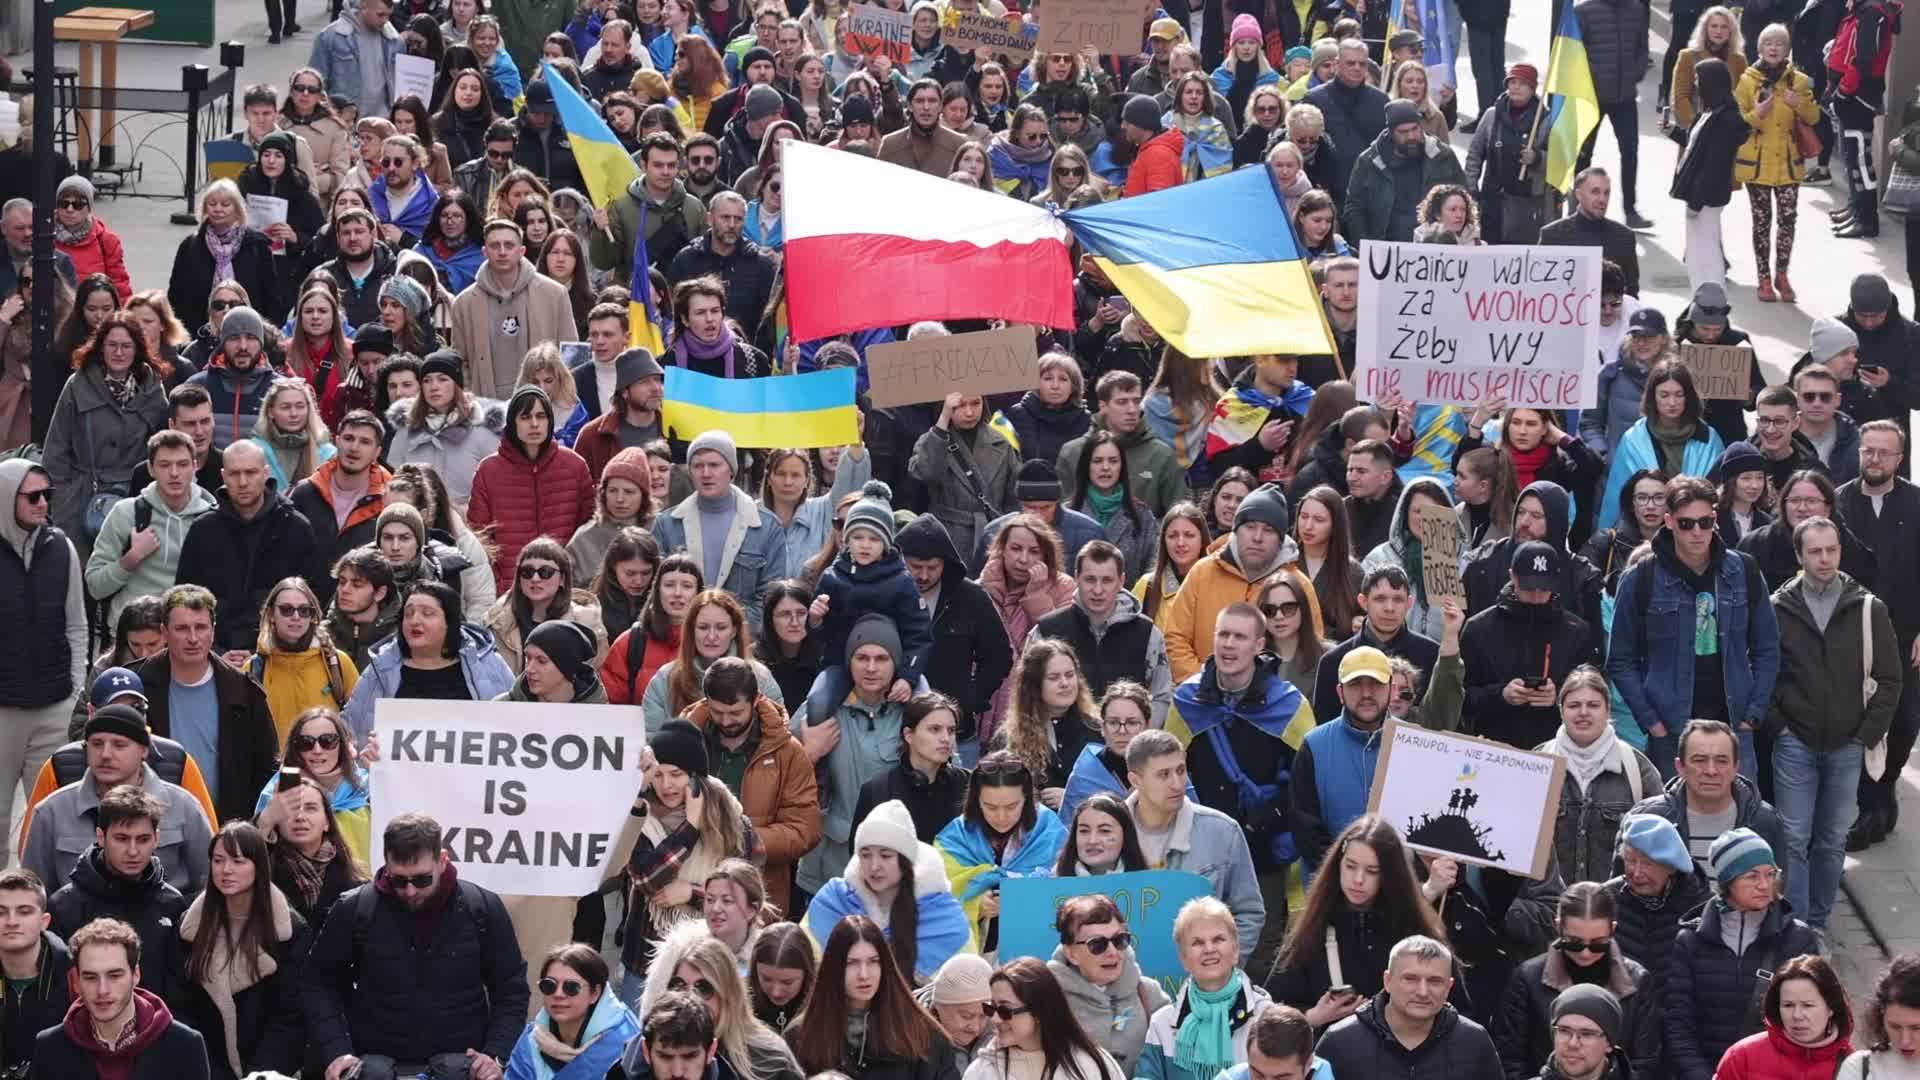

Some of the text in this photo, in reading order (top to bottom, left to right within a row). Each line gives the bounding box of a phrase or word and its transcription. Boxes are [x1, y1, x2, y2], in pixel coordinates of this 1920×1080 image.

[848, 17, 912, 45] UKRAINE
[944, 28, 1036, 51] IS BOMBED DAILY
[961, 15, 1008, 32] MY HOME
[852, 34, 903, 60] WIN
[1369, 245, 1468, 293] Ukraińcy
[1398, 289, 1435, 316] za
[1719, 348, 1748, 373] OUT
[1367, 366, 1580, 405] nie musieliście
[391, 729, 625, 771] KHERSON
[1395, 733, 1450, 753] MARIUPOL
[1464, 748, 1483, 761] NIE
[1485, 751, 1550, 776] ZAPOMNIMY
[483, 779, 528, 816] IS
[441, 827, 609, 868] KRAINE
